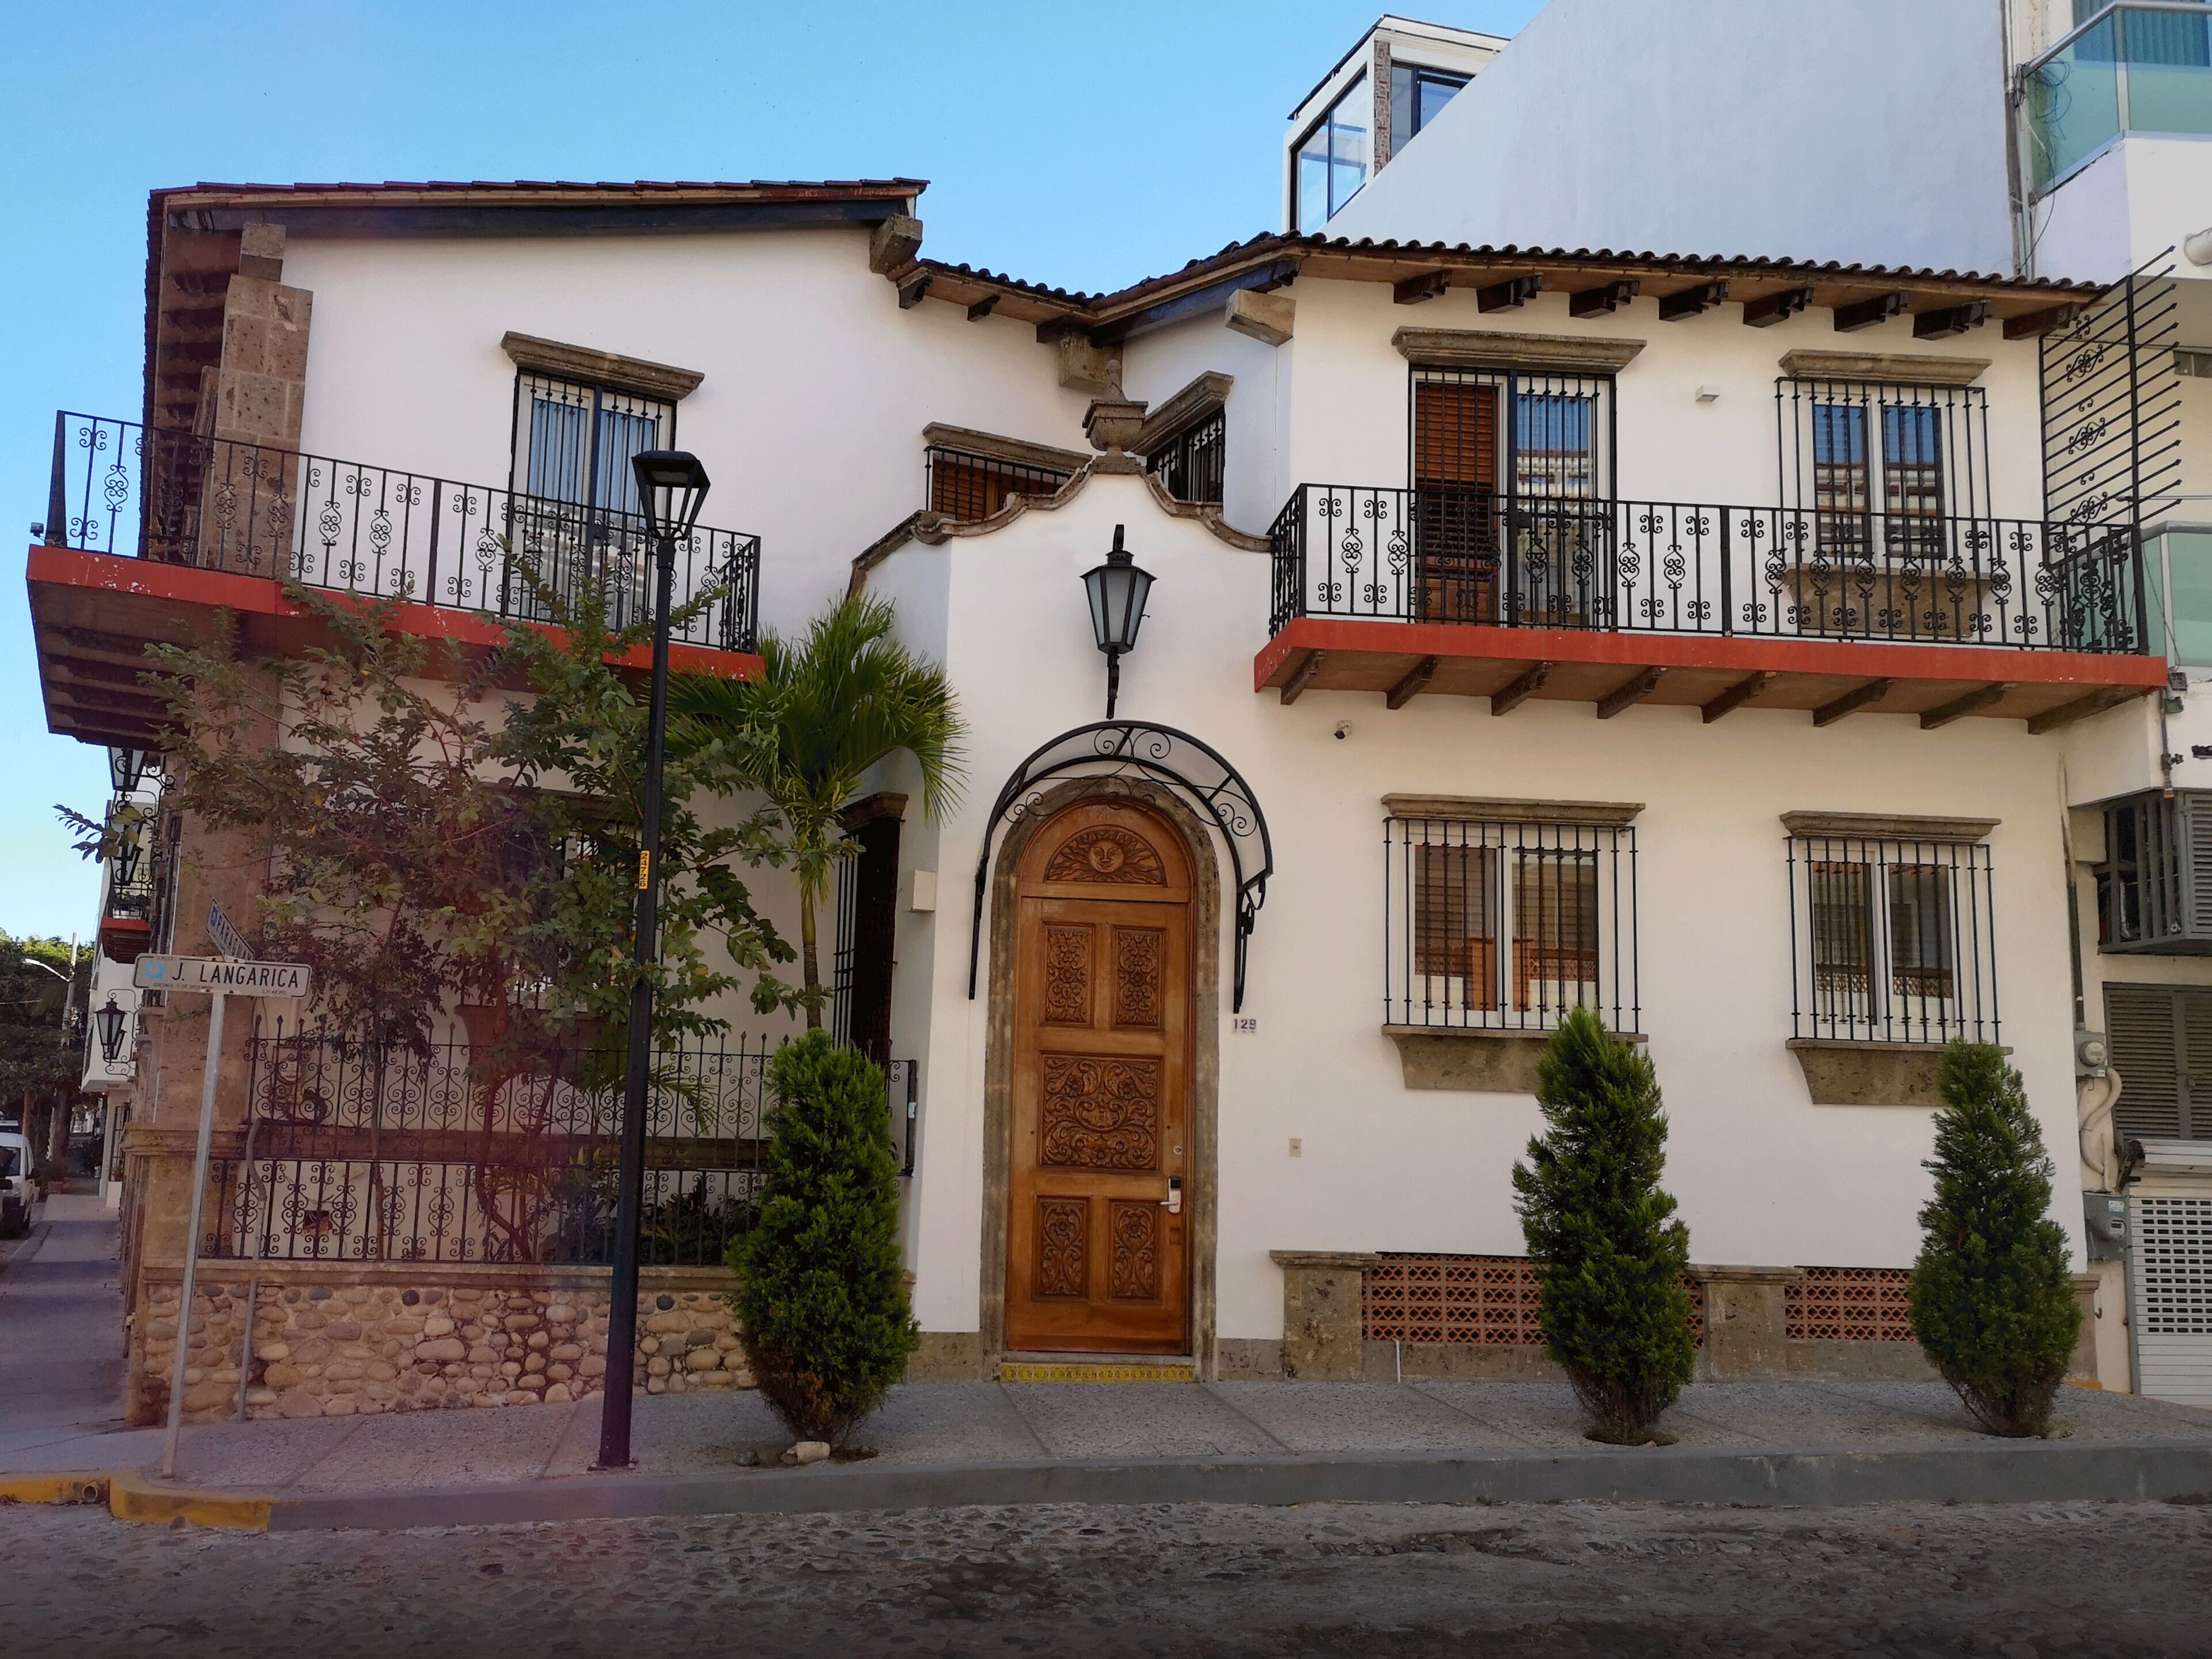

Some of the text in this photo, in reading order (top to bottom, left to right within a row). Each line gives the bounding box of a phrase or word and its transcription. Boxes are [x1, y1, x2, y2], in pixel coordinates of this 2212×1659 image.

[639, 853, 647, 887] 24726
[172, 962, 298, 988] J. LANGARICA
